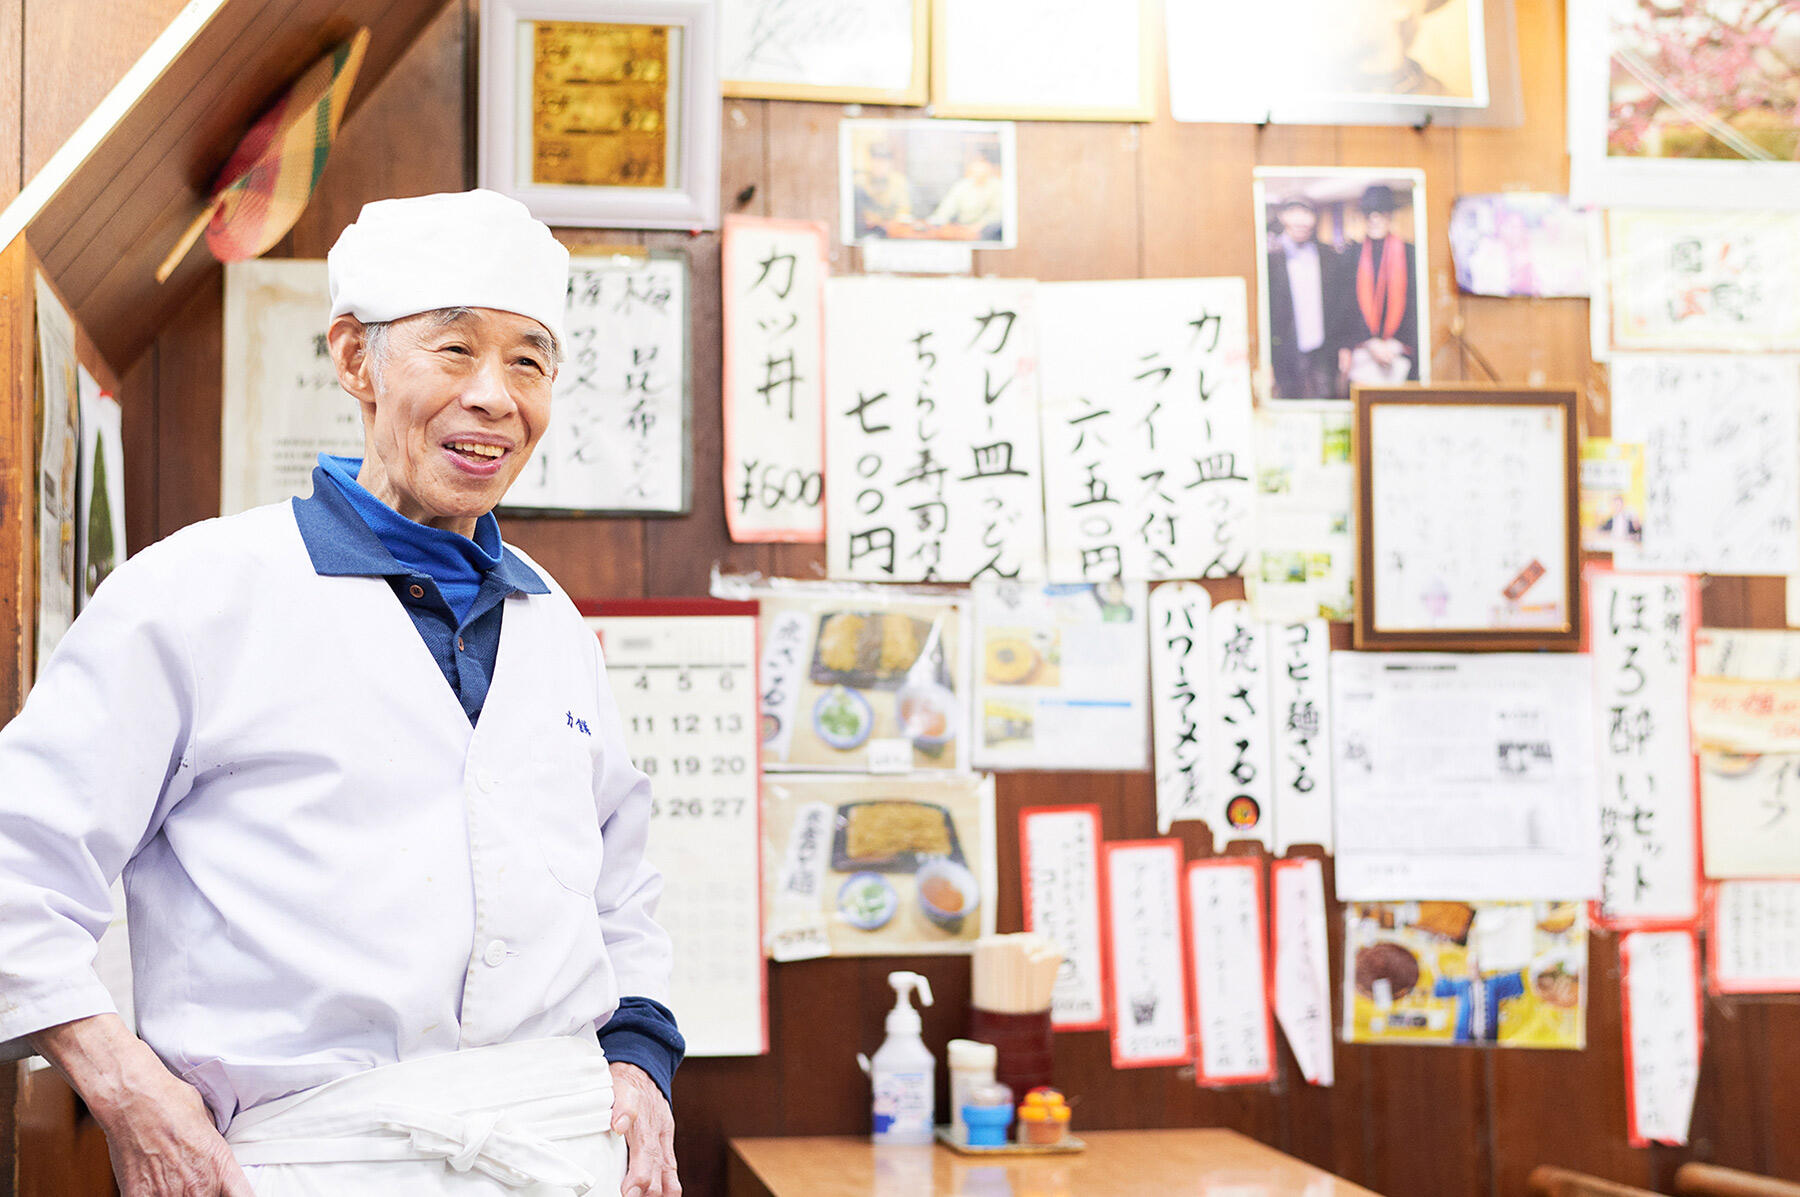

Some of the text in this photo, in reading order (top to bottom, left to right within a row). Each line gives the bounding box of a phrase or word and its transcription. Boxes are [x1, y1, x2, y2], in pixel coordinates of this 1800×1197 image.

[958, 306, 1029, 579] カレー皿うどん
[737, 458, 823, 513] ¥600
[634, 672, 734, 691] 4 5 6
[631, 714, 742, 733] 11 12 13
[672, 757, 700, 775] 19
[712, 757, 746, 774] 20
[669, 799, 704, 817] 26
[712, 799, 746, 817] 27
